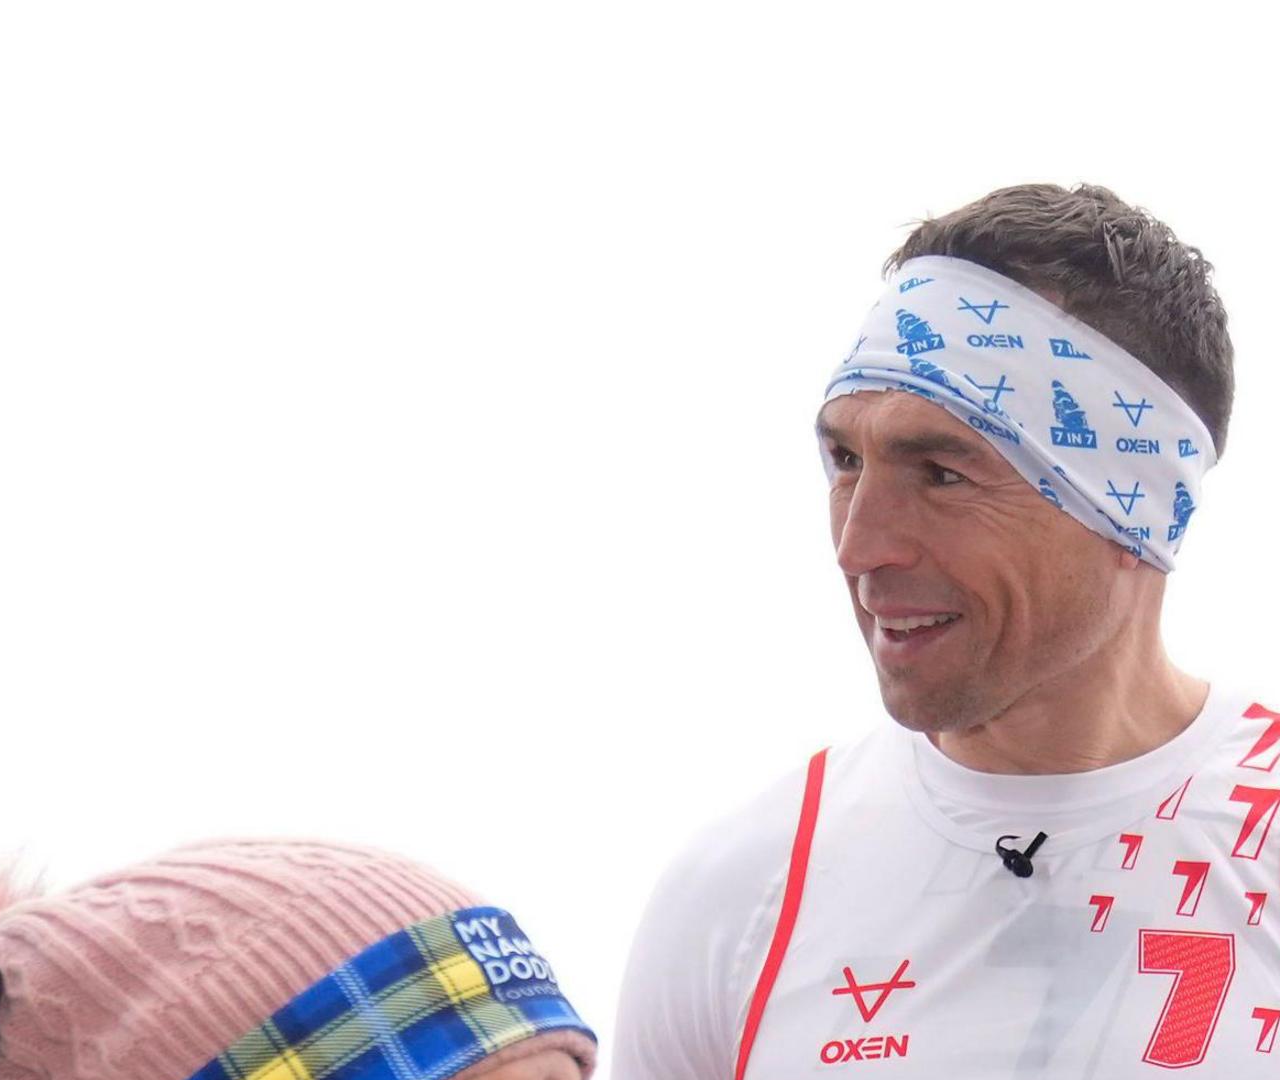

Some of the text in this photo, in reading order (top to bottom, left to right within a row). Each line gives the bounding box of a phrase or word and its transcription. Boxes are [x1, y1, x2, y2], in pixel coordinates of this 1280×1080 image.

[912, 341, 927, 352] IN
[930, 337, 940, 347] 7
[967, 334, 1024, 349] OXEN
[1055, 433, 1094, 445] 7 IN 7
[1116, 438, 1160, 454] OXEN
[1119, 834, 1143, 870] 7
[1173, 861, 1210, 917] 7
[1089, 895, 1114, 932] 7
[1245, 893, 1267, 925] 7
[455, 918, 502, 943] MY
[1138, 930, 1236, 1069] 7
[820, 1035, 909, 1064] OXEN
